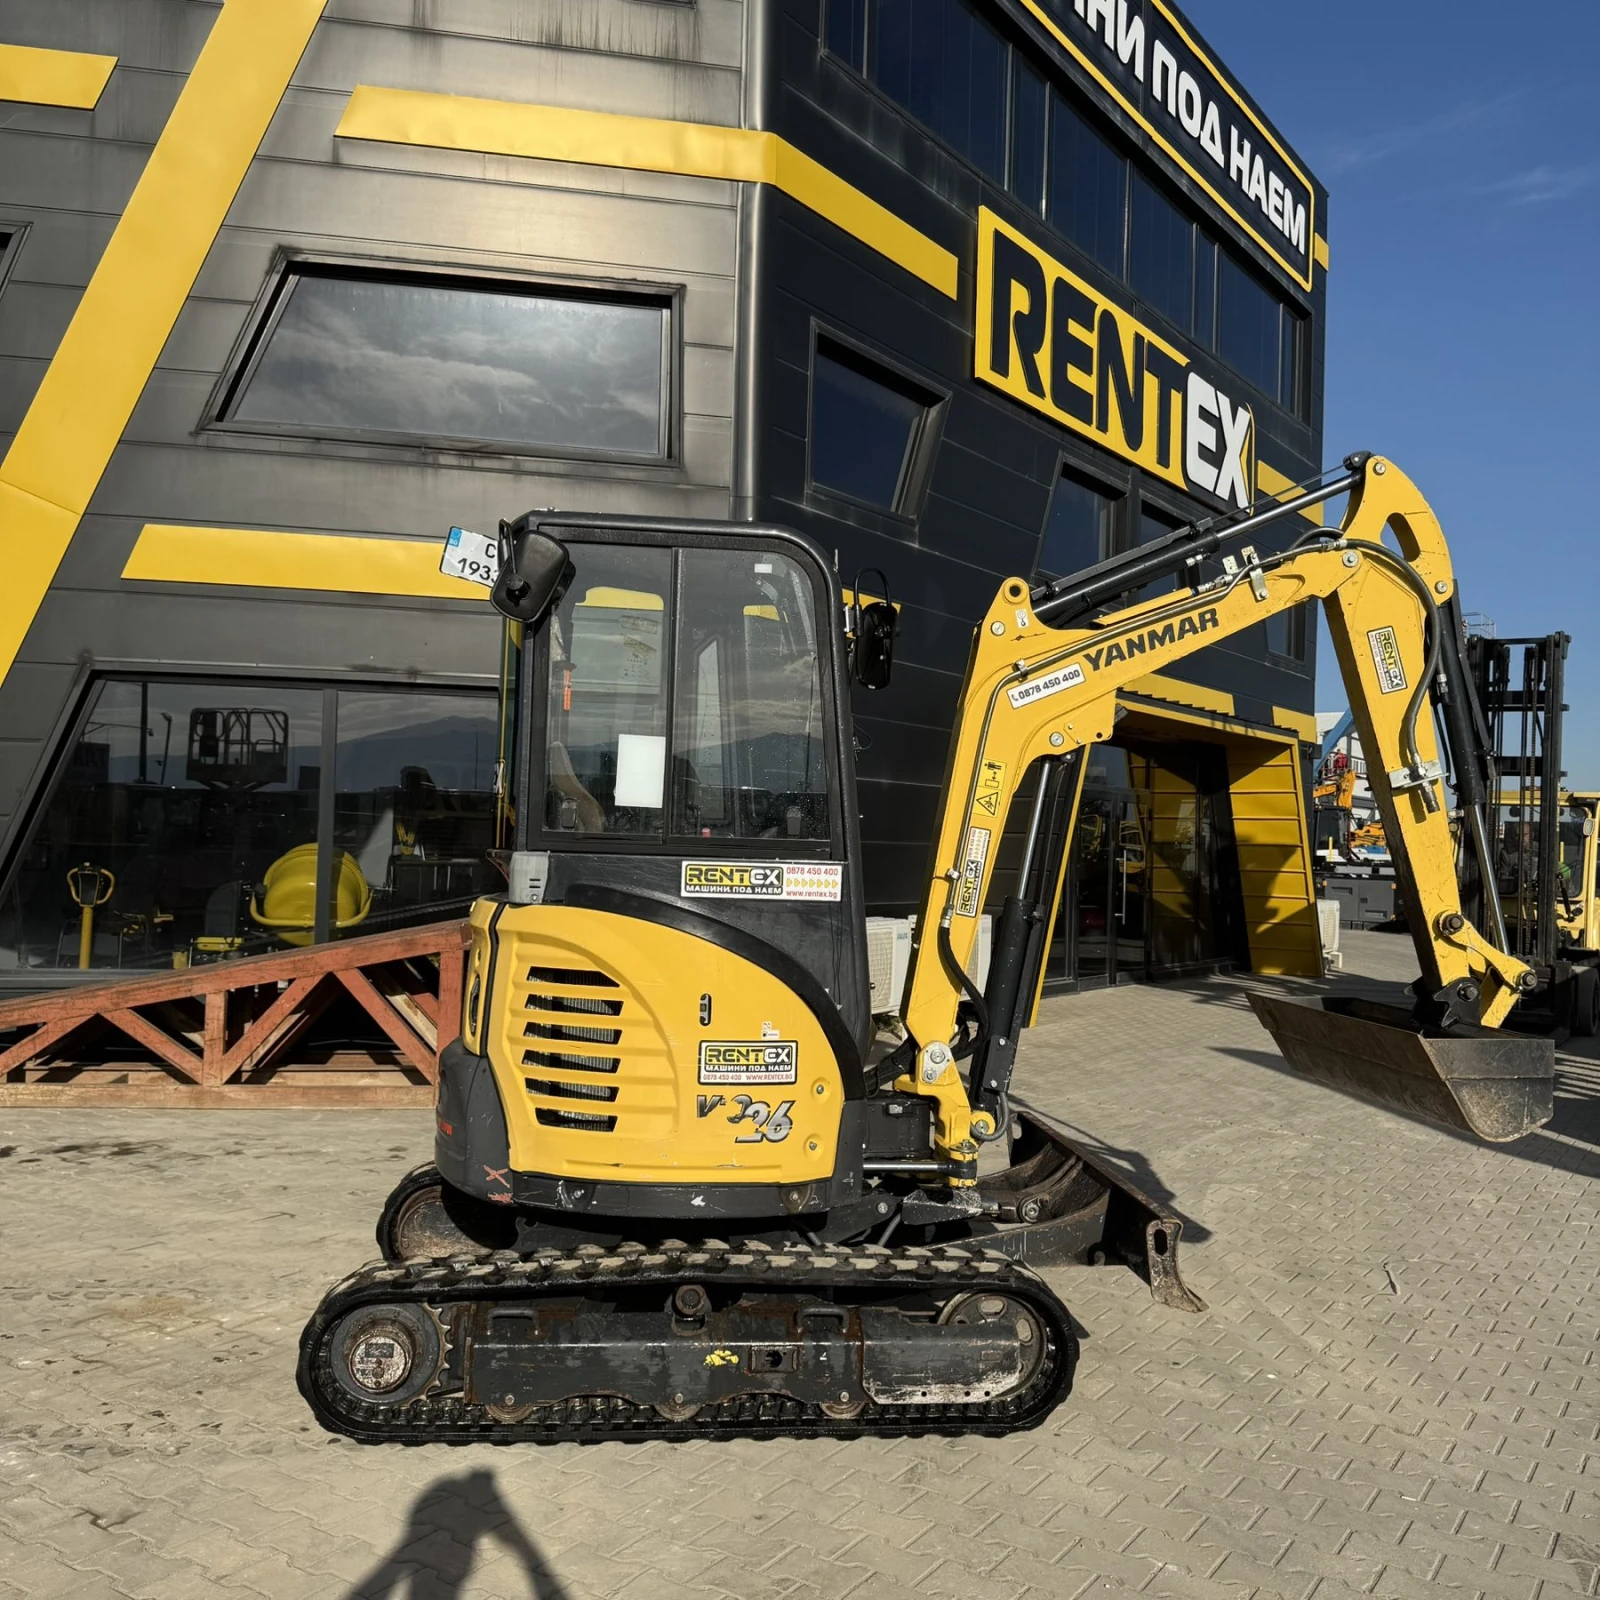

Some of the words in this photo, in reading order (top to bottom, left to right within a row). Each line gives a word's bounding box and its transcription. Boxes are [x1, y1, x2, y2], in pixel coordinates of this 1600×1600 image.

[1074, 0, 1145, 83] НИ
[1153, 40, 1225, 169] ПОД
[1230, 124, 1306, 255] НАЕМ
[990, 227, 1251, 514] RENTEX
[1083, 608, 1220, 672] YANMAR
[1018, 684, 1042, 700] 0878
[1043, 677, 1061, 691] 450
[1062, 669, 1081, 682] 400
[688, 867, 780, 884] RENTEX
[786, 866, 806, 875] 0878
[807, 867, 822, 875] 450
[823, 868, 839, 876] 400
[686, 885, 731, 893] МАШИНИ
[786, 890, 838, 899] www.rentex.bg
[707, 1048, 790, 1063] RENTEX
[705, 1064, 747, 1072] МАШИНИ
